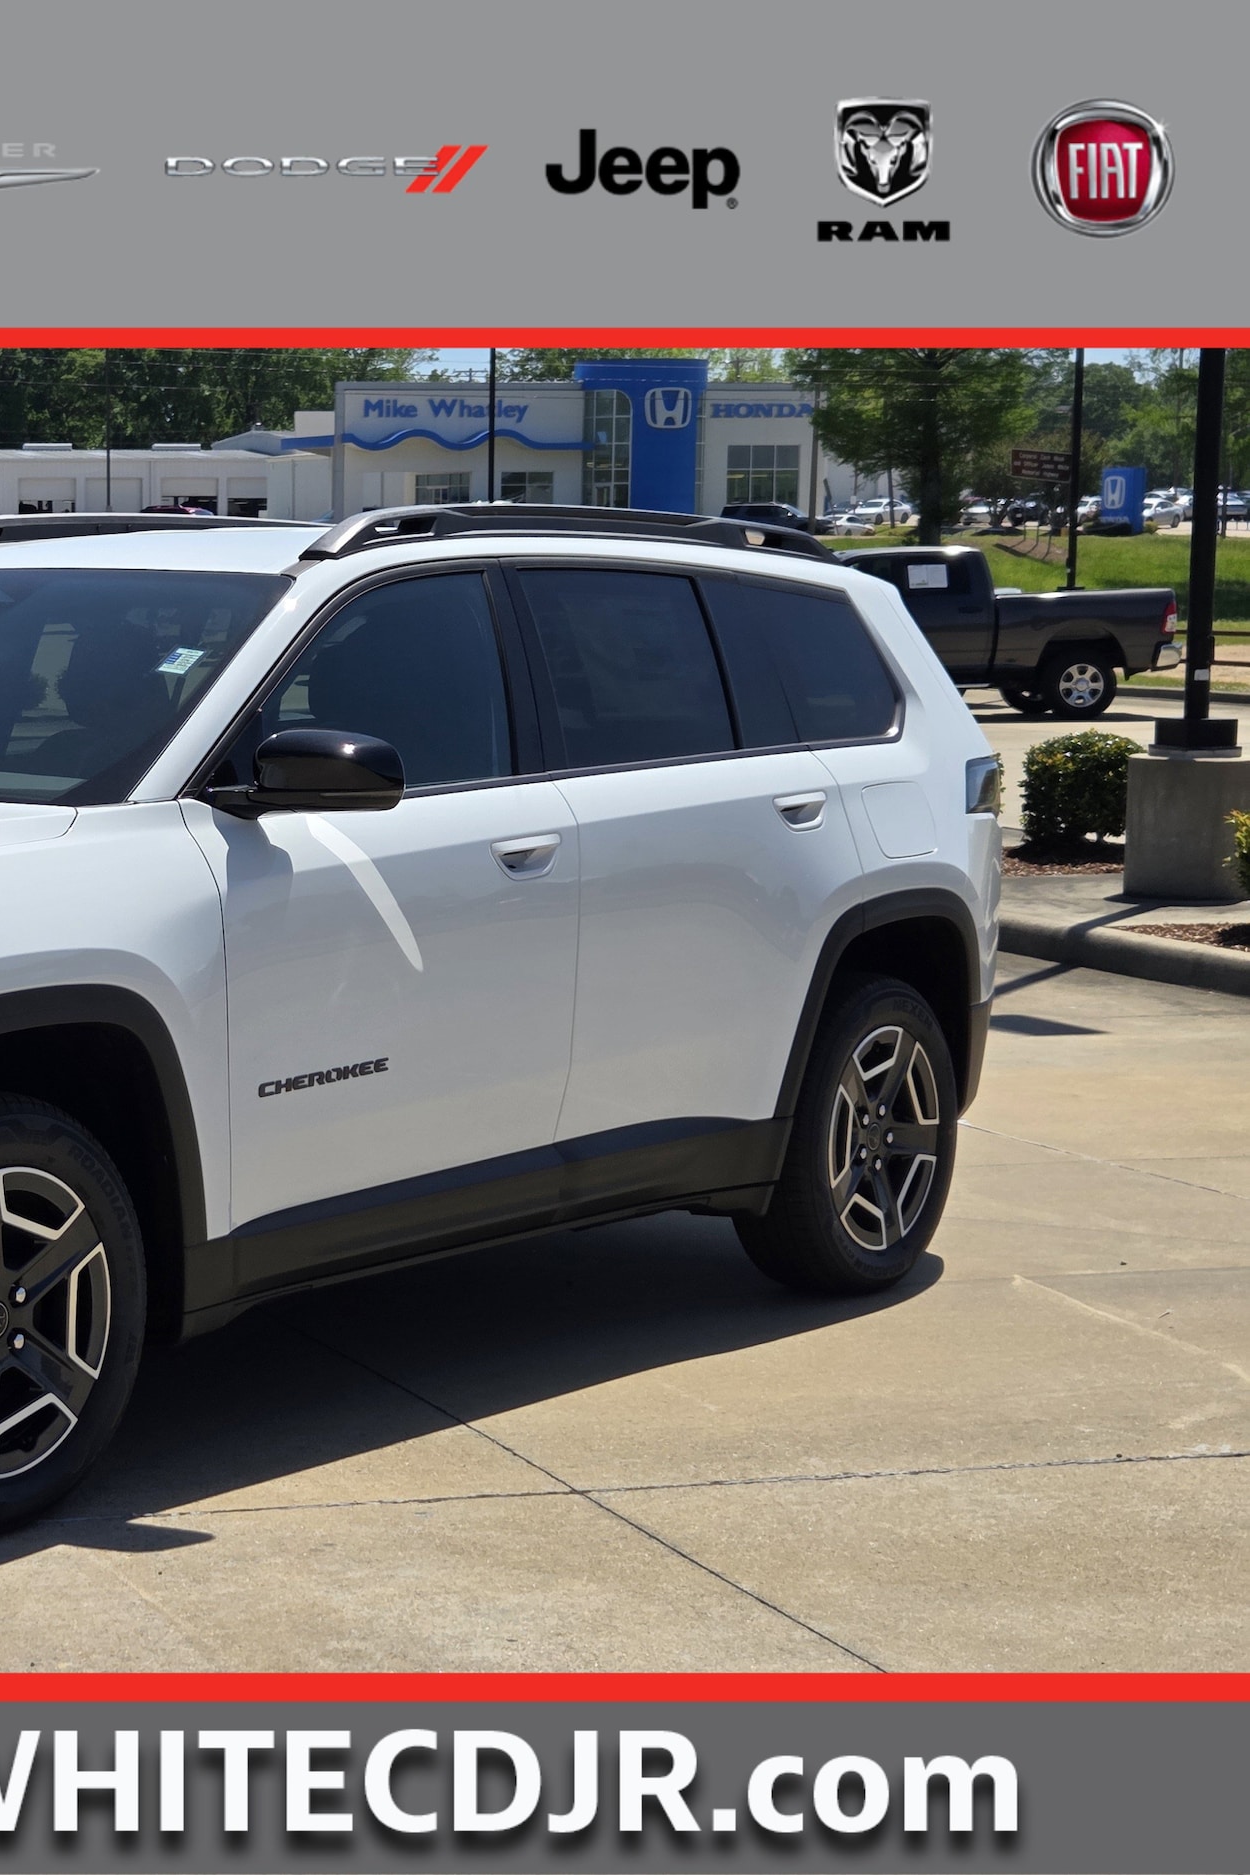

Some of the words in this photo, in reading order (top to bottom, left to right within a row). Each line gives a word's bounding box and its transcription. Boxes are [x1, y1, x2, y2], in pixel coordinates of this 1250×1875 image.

[363, 399, 418, 418] Mike
[427, 399, 529, 423] Whaley
[710, 402, 815, 419] HONDA
[258, 1056, 389, 1098] CHEROKEE
